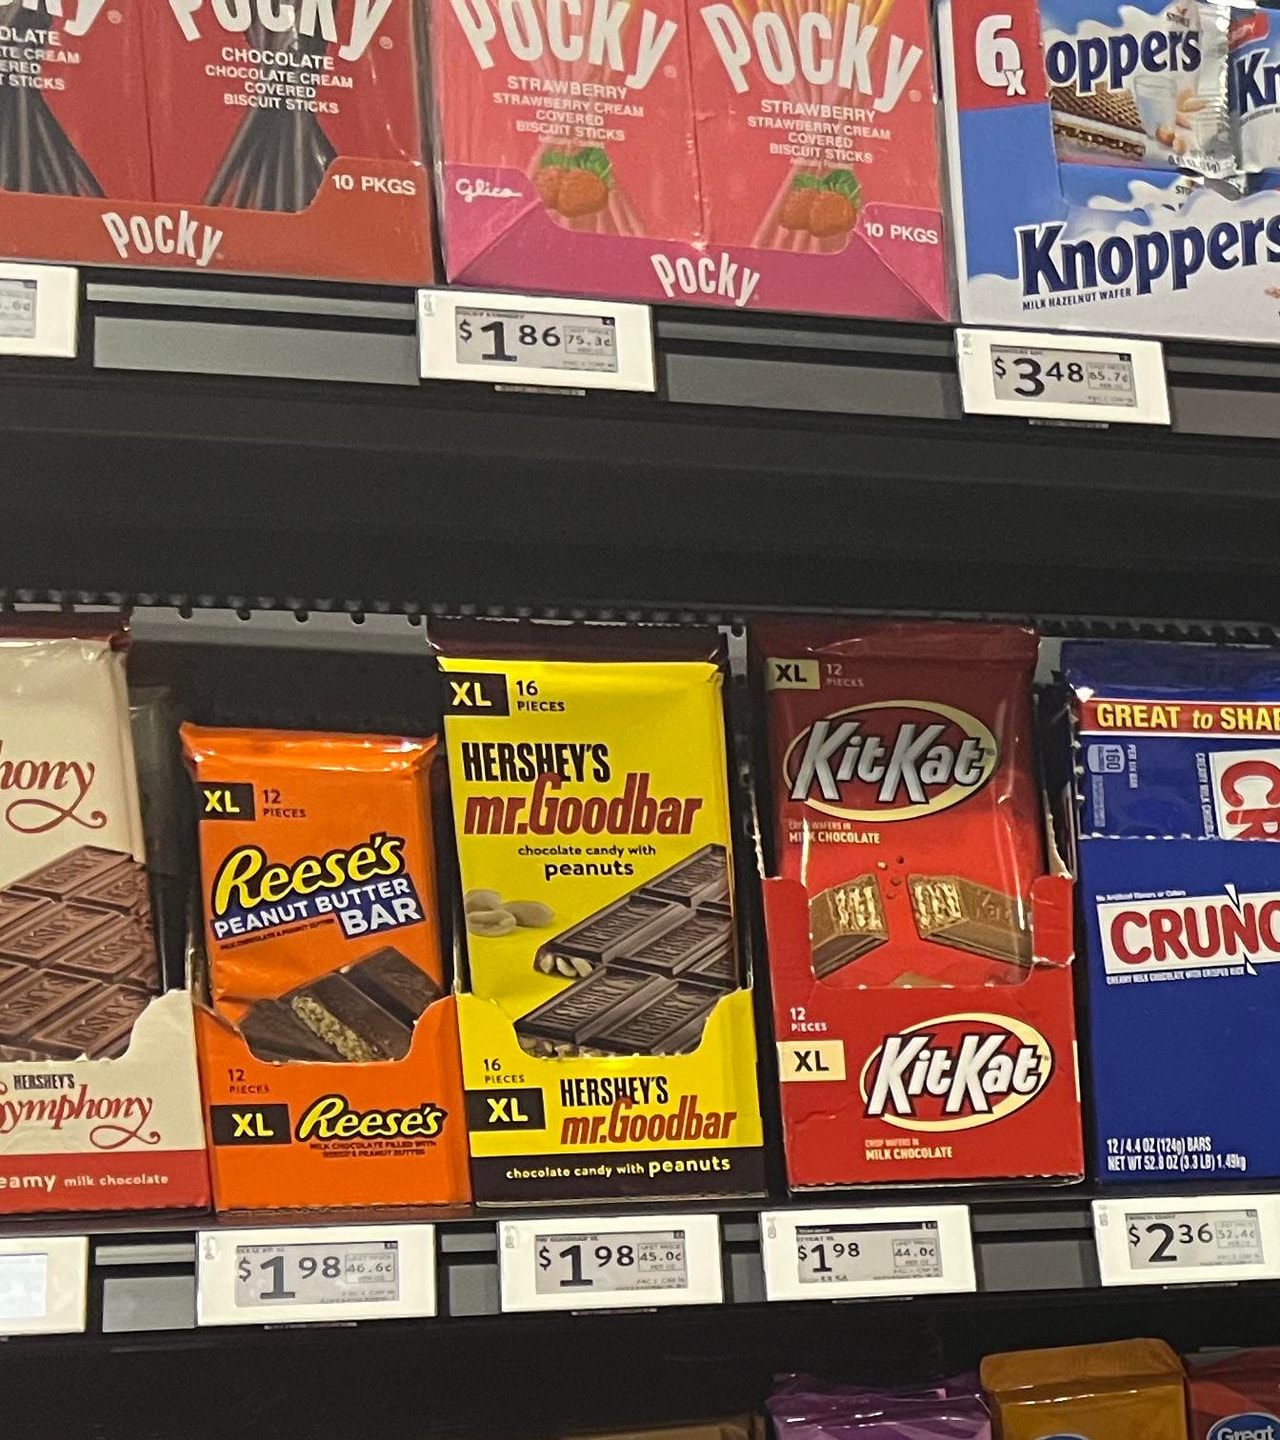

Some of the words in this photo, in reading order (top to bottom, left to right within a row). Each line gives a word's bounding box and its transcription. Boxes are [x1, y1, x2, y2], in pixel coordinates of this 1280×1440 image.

[221, 47, 334, 69] CHOCOLATE
[206, 65, 296, 87] CHOCOLATE
[300, 72, 353, 89] CREAM
[507, 76, 628, 100] STRAWBERRY
[244, 82, 316, 99] COVERED
[224, 94, 280, 111] BISCUIT
[284, 98, 339, 114] STICKS
[332, 175, 352, 191] 10
[360, 176, 416, 196] PKGS
[1022, 300, 1046, 311] MILK
[1048, 292, 1096, 307] HAZELNUT
[1099, 288, 1131, 300] WAFER
[450, 682, 492, 707] XL
[516, 680, 538, 697] 16
[517, 701, 565, 712] PIECES
[1097, 704, 1182, 729] GREAT
[1193, 710, 1213, 729] to
[461, 742, 611, 783] HERSHEY'S
[204, 790, 241, 813] XL
[262, 789, 282, 805] 12
[464, 773, 702, 836] mr.Goodbar
[262, 807, 306, 819] PIECES
[518, 845, 581, 856] chocolate
[586, 845, 624, 859] candy
[628, 845, 655, 855] with
[214, 833, 405, 918] Reese's
[545, 860, 633, 881] peanuts
[214, 902, 309, 939] PEANUT
[315, 878, 411, 912] BUTTER
[343, 898, 421, 936] BAR
[560, 1076, 668, 1107] HERSHEY'S
[300, 1098, 442, 1139] Reese's
[866, 1147, 892, 1160] MILK
[895, 1146, 953, 1159] CHOCOLATE
[1107, 1139, 1119, 1154] 12
[1126, 1138, 1142, 1153] 4.4
[1142, 1138, 1155, 1152] OZ
[1187, 1137, 1211, 1152] BARS
[1108, 1156, 1126, 1171] NET
[1128, 1156, 1142, 1170] WT
[1144, 1155, 1164, 1170] 52.8
[1166, 1155, 1179, 1170] OZ
[64, 1176, 95, 1188] milk
[100, 1172, 169, 1186] chocolate
